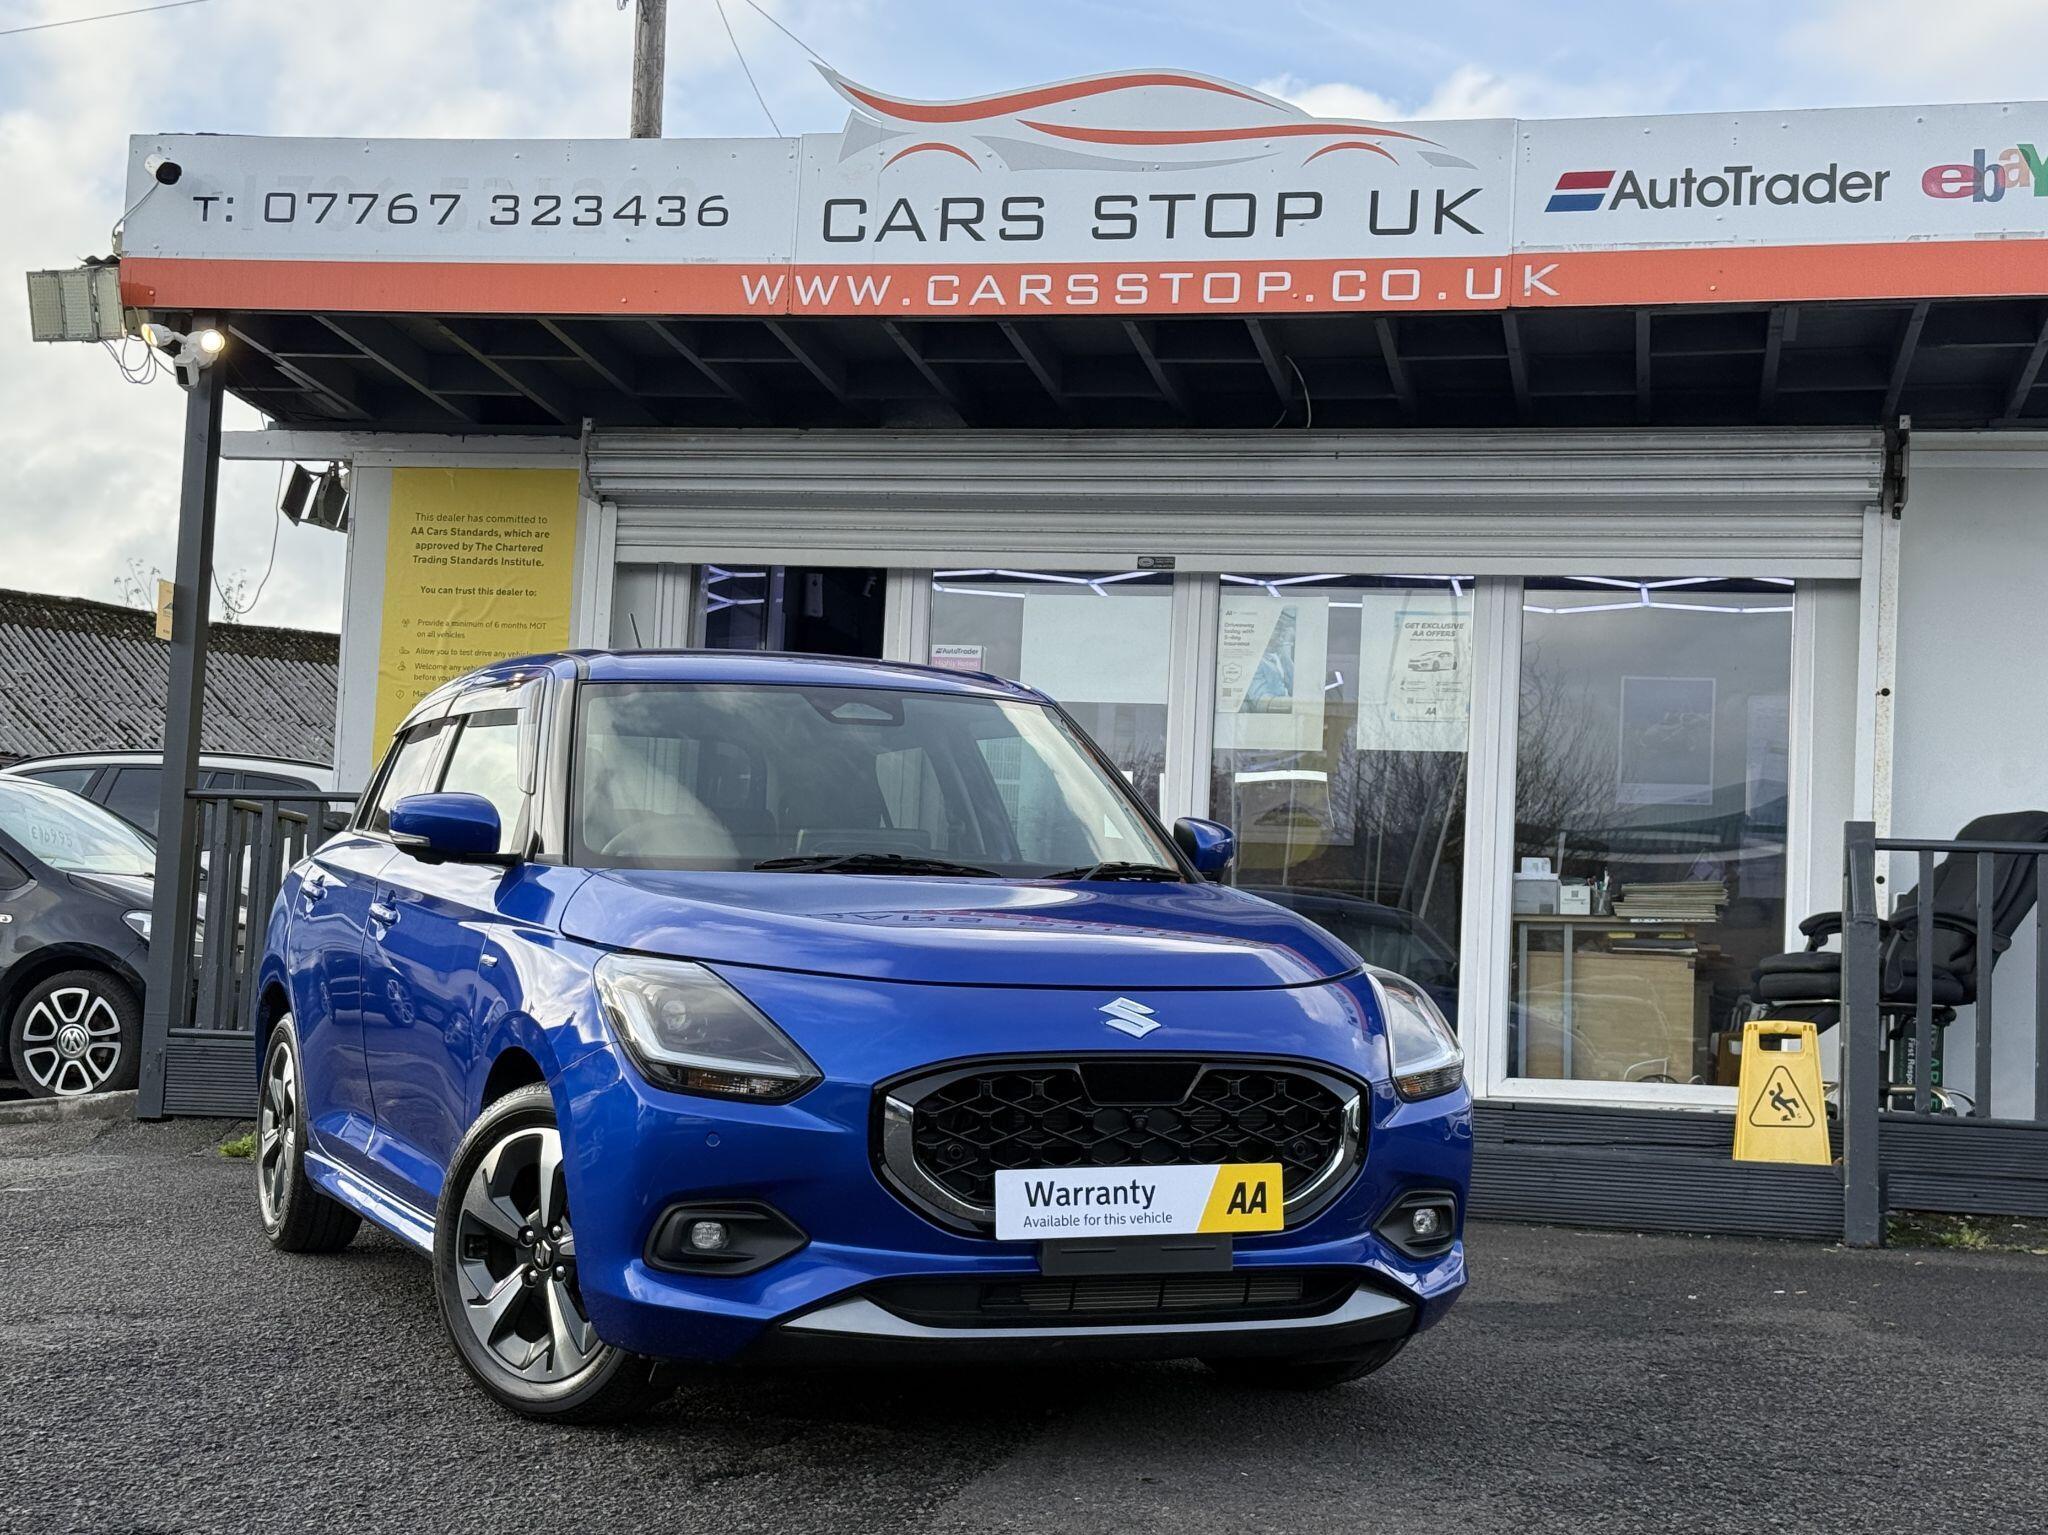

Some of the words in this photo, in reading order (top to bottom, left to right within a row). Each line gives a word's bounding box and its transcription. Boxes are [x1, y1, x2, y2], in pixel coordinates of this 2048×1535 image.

[1608, 163, 1890, 210] AutoTrader
[193, 196, 235, 222] T:
[263, 193, 462, 225] 07767
[489, 194, 729, 227] 323436
[822, 196, 1046, 243] CARS
[1091, 192, 1323, 240] STOP
[1368, 188, 1485, 236] UK
[415, 512, 434, 522] This
[436, 513, 465, 523] dealer
[467, 514, 483, 523] has
[486, 515, 535, 524] committed
[538, 515, 548, 524] to
[410, 526, 424, 536] AA
[427, 527, 447, 536] Cars
[450, 527, 501, 538] Standards,
[504, 529, 532, 538] which
[534, 531, 550, 539] are
[415, 542, 460, 551] approved
[462, 543, 473, 552] by
[475, 543, 493, 552] The
[495, 543, 543, 553] Chartered
[413, 555, 447, 566] Trading
[450, 556, 498, 566] Standards
[501, 557, 544, 567] Institute.
[420, 586, 436, 594] You
[438, 587, 453, 595] can
[456, 586, 475, 595] trust
[478, 587, 494, 595] this
[496, 587, 523, 596] dealer
[417, 619, 444, 627] Provide
[451, 620, 484, 629] minimum
[485, 620, 493, 628] of
[501, 620, 528, 629] months
[529, 622, 547, 630] MOT
[437, 631, 465, 639] vehicles
[416, 648, 434, 656] Allow
[436, 649, 449, 657] you
[450, 648, 458, 656] to
[475, 649, 492, 657] drive
[494, 650, 506, 659] any
[415, 663, 447, 671] Welcome
[449, 664, 461, 672] any
[414, 673, 437, 681] before
[1024, 1179, 1156, 1210] Warranty
[1226, 1181, 1267, 1214] AA
[1023, 1214, 1080, 1228] Available
[1084, 1213, 1101, 1226] for
[1104, 1213, 1126, 1225] this
[1129, 1211, 1173, 1225] vehicle
